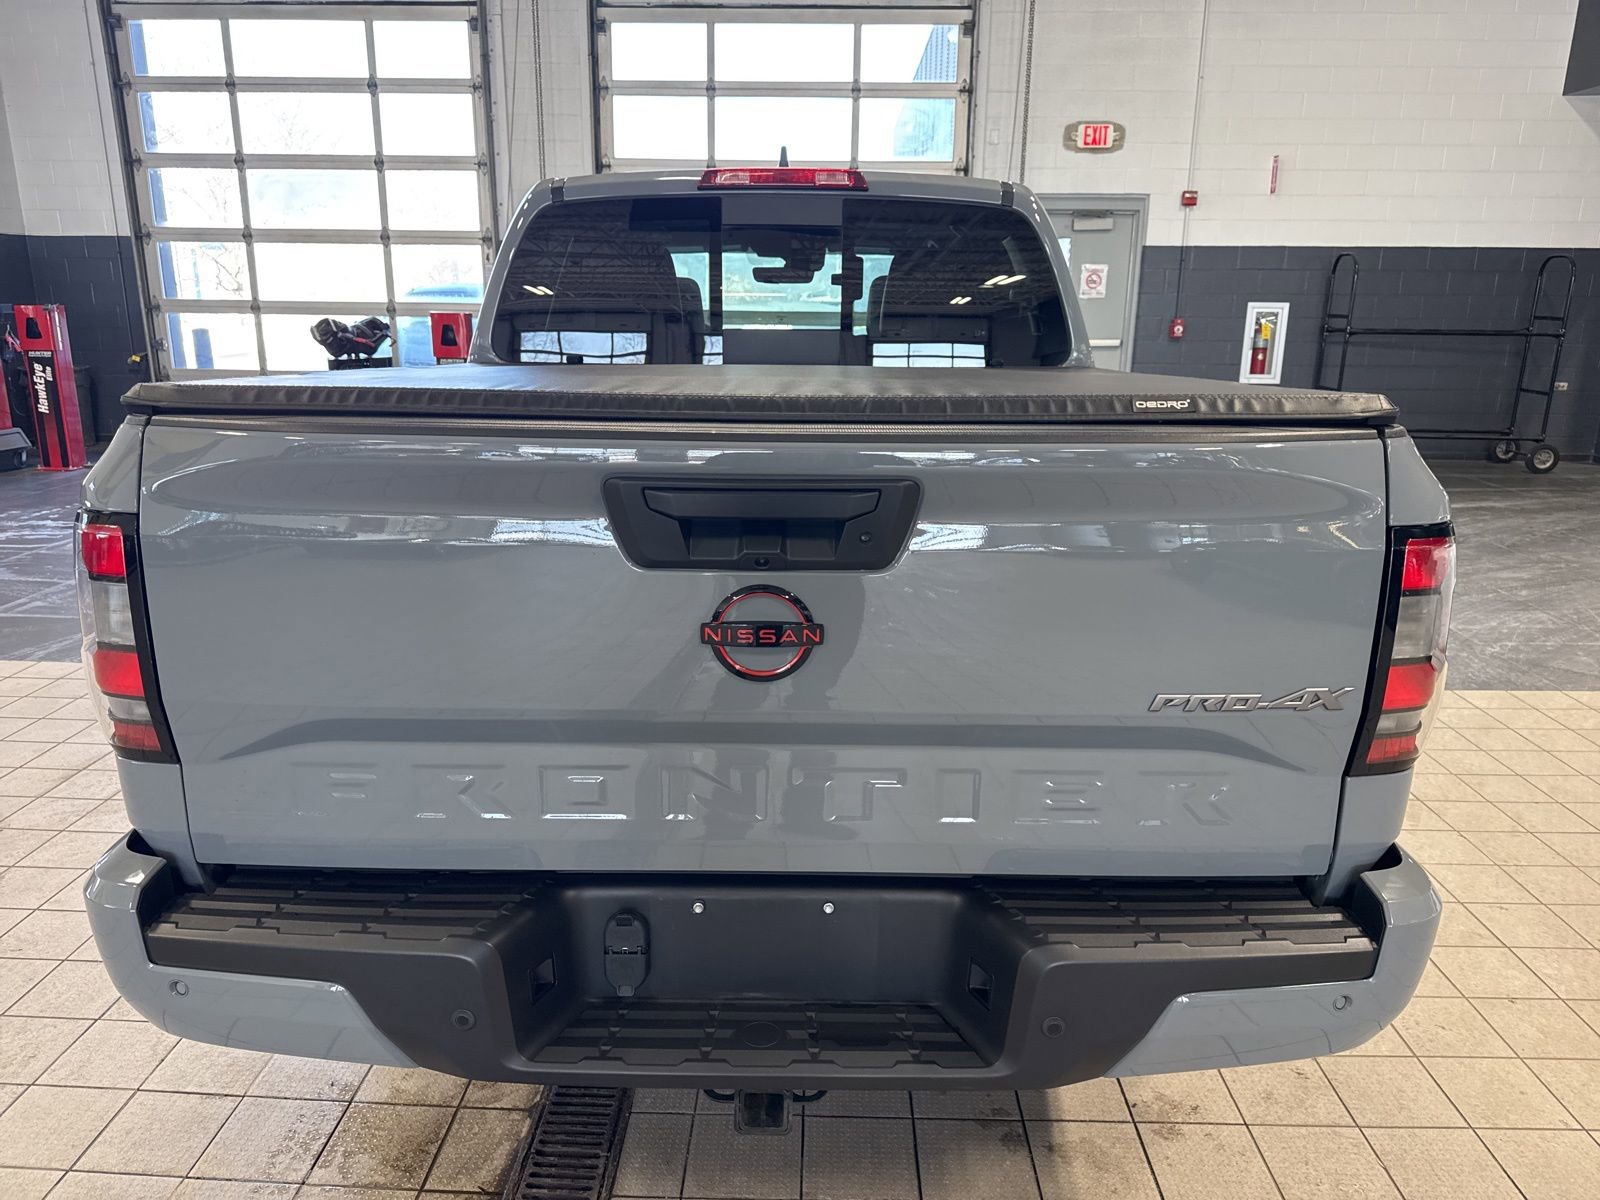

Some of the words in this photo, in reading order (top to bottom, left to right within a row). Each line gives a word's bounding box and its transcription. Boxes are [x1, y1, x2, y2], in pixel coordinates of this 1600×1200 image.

[1083, 125, 1110, 146] EXIT
[33, 363, 50, 413] HawkEye
[1135, 400, 1189, 410] OEDRO
[704, 626, 821, 644] NISSAN
[1147, 687, 1356, 713] PRO-4X
[289, 762, 1234, 826] FRONTIER
